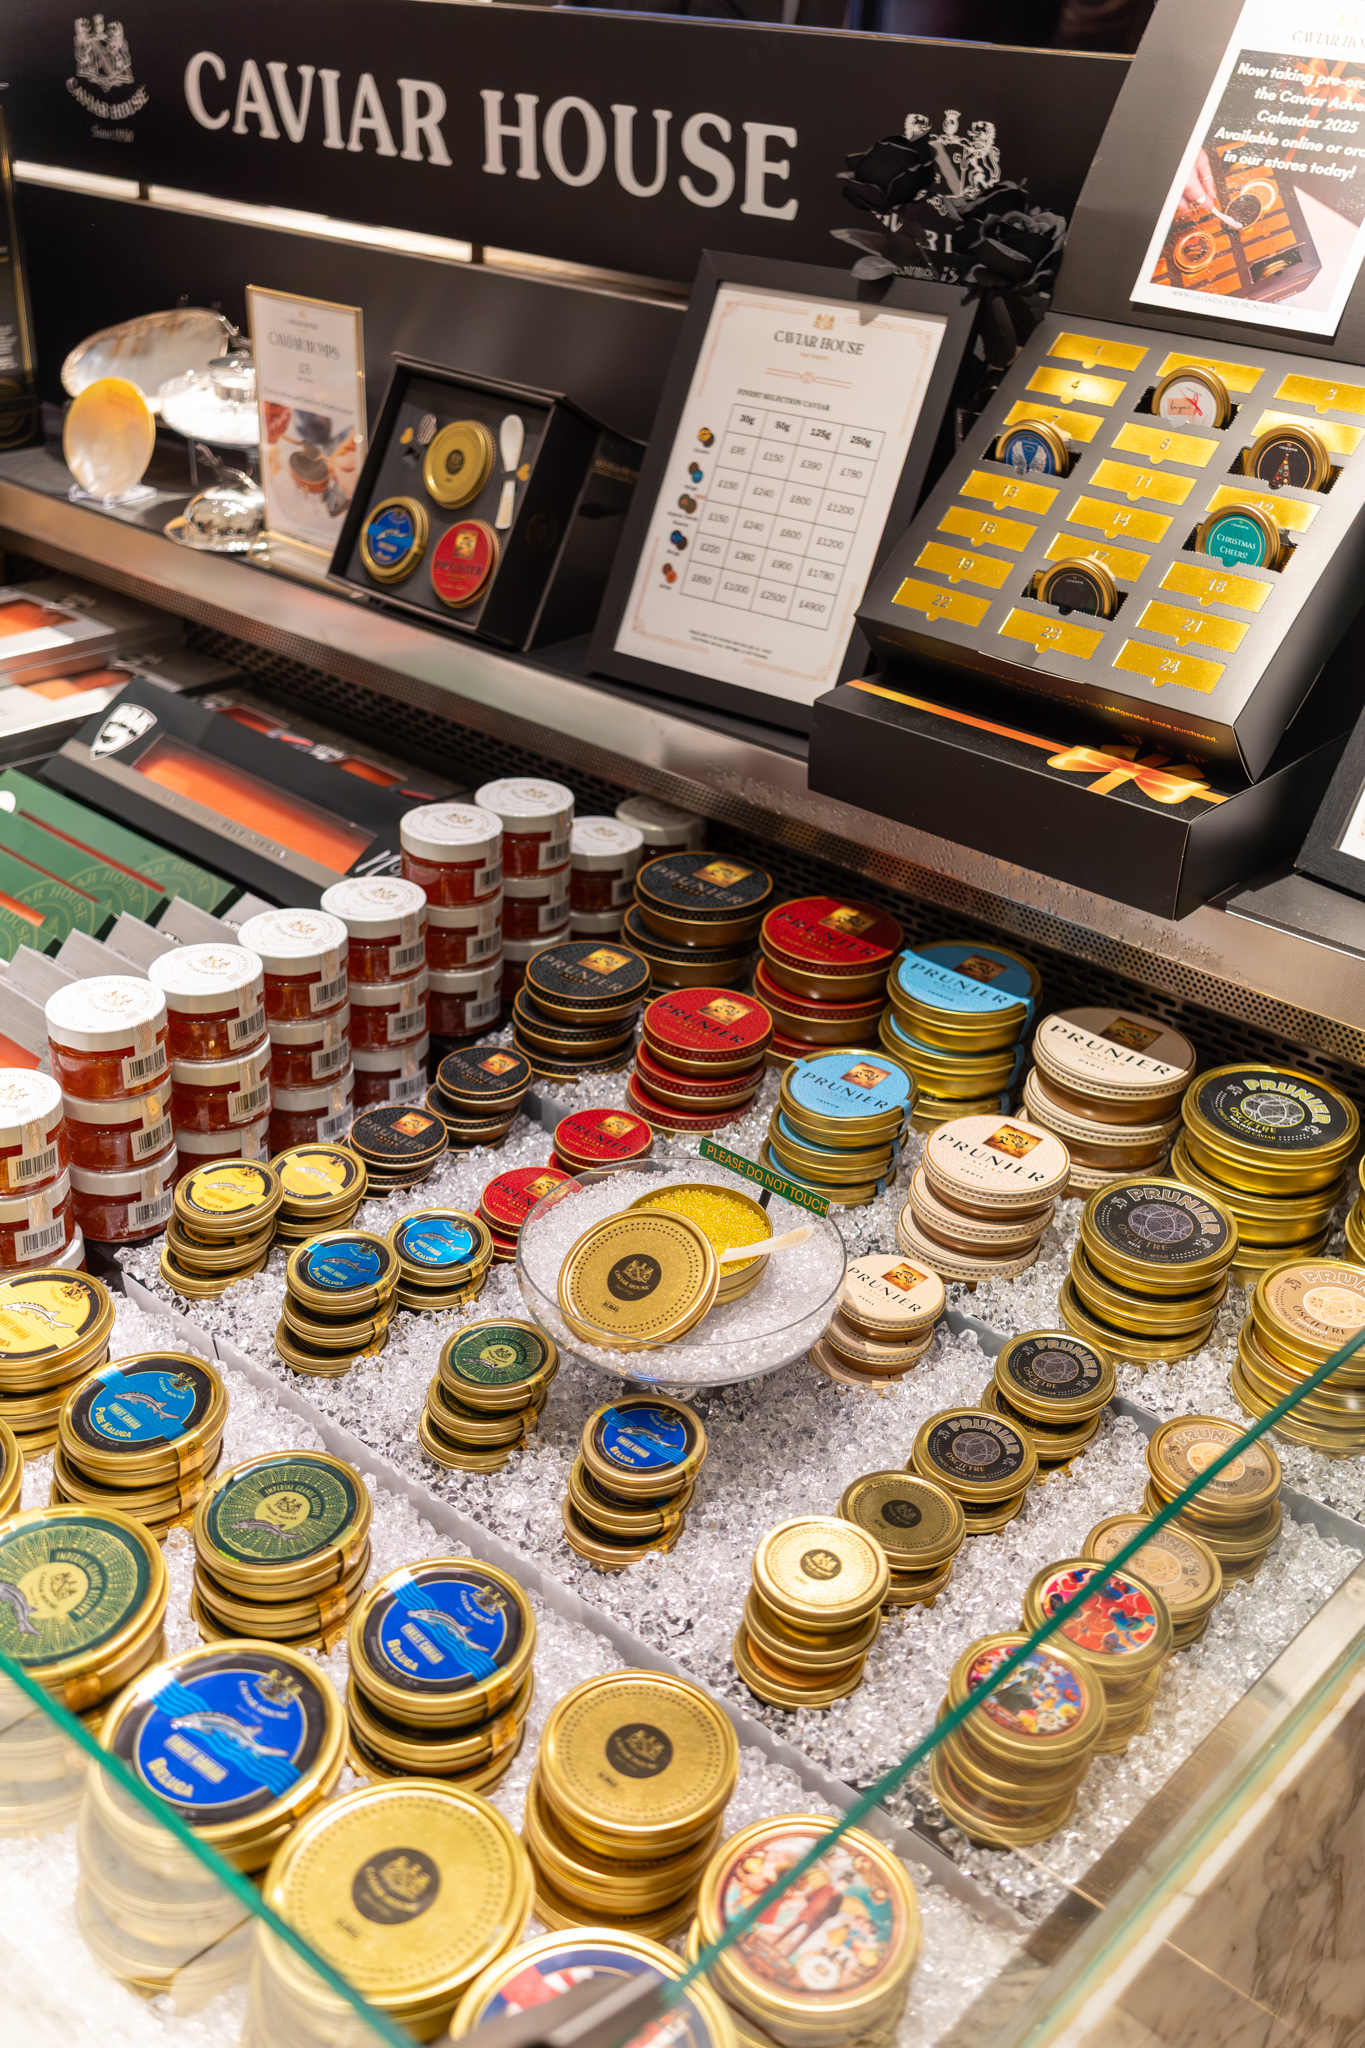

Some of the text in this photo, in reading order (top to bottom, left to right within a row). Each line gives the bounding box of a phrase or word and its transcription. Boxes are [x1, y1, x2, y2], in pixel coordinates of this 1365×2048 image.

[1293, 31, 1365, 49] CAVIAR HO
[1237, 62, 1268, 77] Now
[1270, 67, 1314, 86] taking
[1254, 86, 1365, 112] the Caviar Adve
[1257, 110, 1360, 134] Calendar 2025
[183, 49, 800, 222] CAVIAR HOUSE
[1214, 126, 1342, 153] Available online or
[1223, 150, 1357, 180] in our stores today!
[774, 330, 818, 350] CAVIAR
[820, 337, 864, 356] HOUSE
[1094, 345, 1103, 355] 1
[1070, 380, 1081, 390] 4
[1325, 388, 1337, 400] 3
[739, 414, 873, 448] 30g 50g 125g 250g
[1050, 415, 1062, 425] 7
[1159, 439, 1171, 450] 8
[1002, 484, 1019, 498] 13
[1136, 474, 1153, 488] 11
[752, 486, 855, 516] £240 £1200
[980, 521, 997, 534] 16
[1112, 512, 1130, 526] 14
[742, 520, 844, 550] £240 £1200
[1216, 533, 1256, 550] CHRISTMAS
[956, 557, 974, 571] 19
[1219, 546, 1249, 559] CHEERS!
[1207, 578, 1227, 593] 18
[931, 594, 952, 608] 22
[1041, 625, 1062, 640] 23
[1181, 617, 1204, 633] 21
[1157, 658, 1181, 673] 24
[1104, 705, 1219, 744] refrigerated once purchased.
[103, 870, 141, 903] HOUSE
[174, 862, 210, 892] HOUSE
[651, 864, 745, 905] PRUNIER
[50, 885, 88, 923] HOUSE
[776, 912, 876, 957] PRUNIER
[540, 954, 623, 992] PRUNIER
[910, 962, 1009, 1004] PRUNIER
[658, 1002, 745, 1043] PRUNIER
[1050, 1024, 1171, 1077] PRUNIER
[1080, 1047, 1125, 1068] CAVIAR
[449, 1056, 508, 1088] PRUNIER
[1078, 1058, 1106, 1071] PARIS
[802, 1072, 889, 1109] PRUNIER
[1243, 1079, 1331, 1124] PRUNIER
[1229, 1106, 1277, 1133] OSCIETRE
[359, 1116, 426, 1152] PRUNIER
[564, 1120, 631, 1154] PRUNIER
[938, 1133, 1045, 1183] PRUNIER
[962, 1155, 1003, 1175] CAVIAR
[706, 1144, 830, 1215] PLEASE DO NOT TOUCH
[960, 1166, 984, 1179] PARIS
[197, 1196, 224, 1210] OSCIETRA
[1126, 1187, 1221, 1236] PRUNIER
[416, 1239, 442, 1257] FINEST CAVIAR
[1116, 1223, 1169, 1251] OSCIETRE
[407, 1241, 437, 1262] PURE KALUGA
[312, 1267, 344, 1286] PURE KALUGA
[320, 1264, 348, 1281] FINEST CAVIAR
[614, 1269, 651, 1291] CAVIAR HOUSE
[49, 1286, 78, 1310] CAVIAR HOUSE
[848, 1267, 921, 1312] PRUNIER
[858, 1295, 874, 1306] PARIS
[602, 1301, 620, 1313] ALMAS
[15, 1325, 31, 1340] CAVIAR
[1292, 1305, 1348, 1336] OSCIETRE
[1296, 1318, 1328, 1335] SUPERIEUR
[1034, 1339, 1098, 1378] PRUNIER
[158, 1377, 186, 1400] CAVIAR HOUSE
[1023, 1366, 1058, 1389] OSCIETRE
[95, 1406, 132, 1439] PURE KALUGA
[108, 1403, 141, 1430] FINEST CAVIAR
[616, 1435, 651, 1459] FINEST CAVIAR
[947, 1418, 1020, 1455] PRUNIER
[609, 1445, 635, 1465] BELUGA
[945, 1452, 985, 1472] OSCIETRE
[264, 1483, 322, 1517] IMPERIAL GRANDE RESERVE
[265, 1503, 278, 1517] CAVIAR
[56, 1552, 91, 1567] IMPERIAL
[38, 1572, 58, 1609] CAVIAR HOUSE
[459, 1590, 496, 1626] CAVIAR HOUSE
[386, 1638, 419, 1672] BELUGA
[401, 1622, 444, 1664] FINEST CAVIAR
[237, 1680, 290, 1720] CAVIAR HOUSE
[614, 1736, 633, 1761] CAVIAR
[147, 1757, 195, 1798] BELUGA
